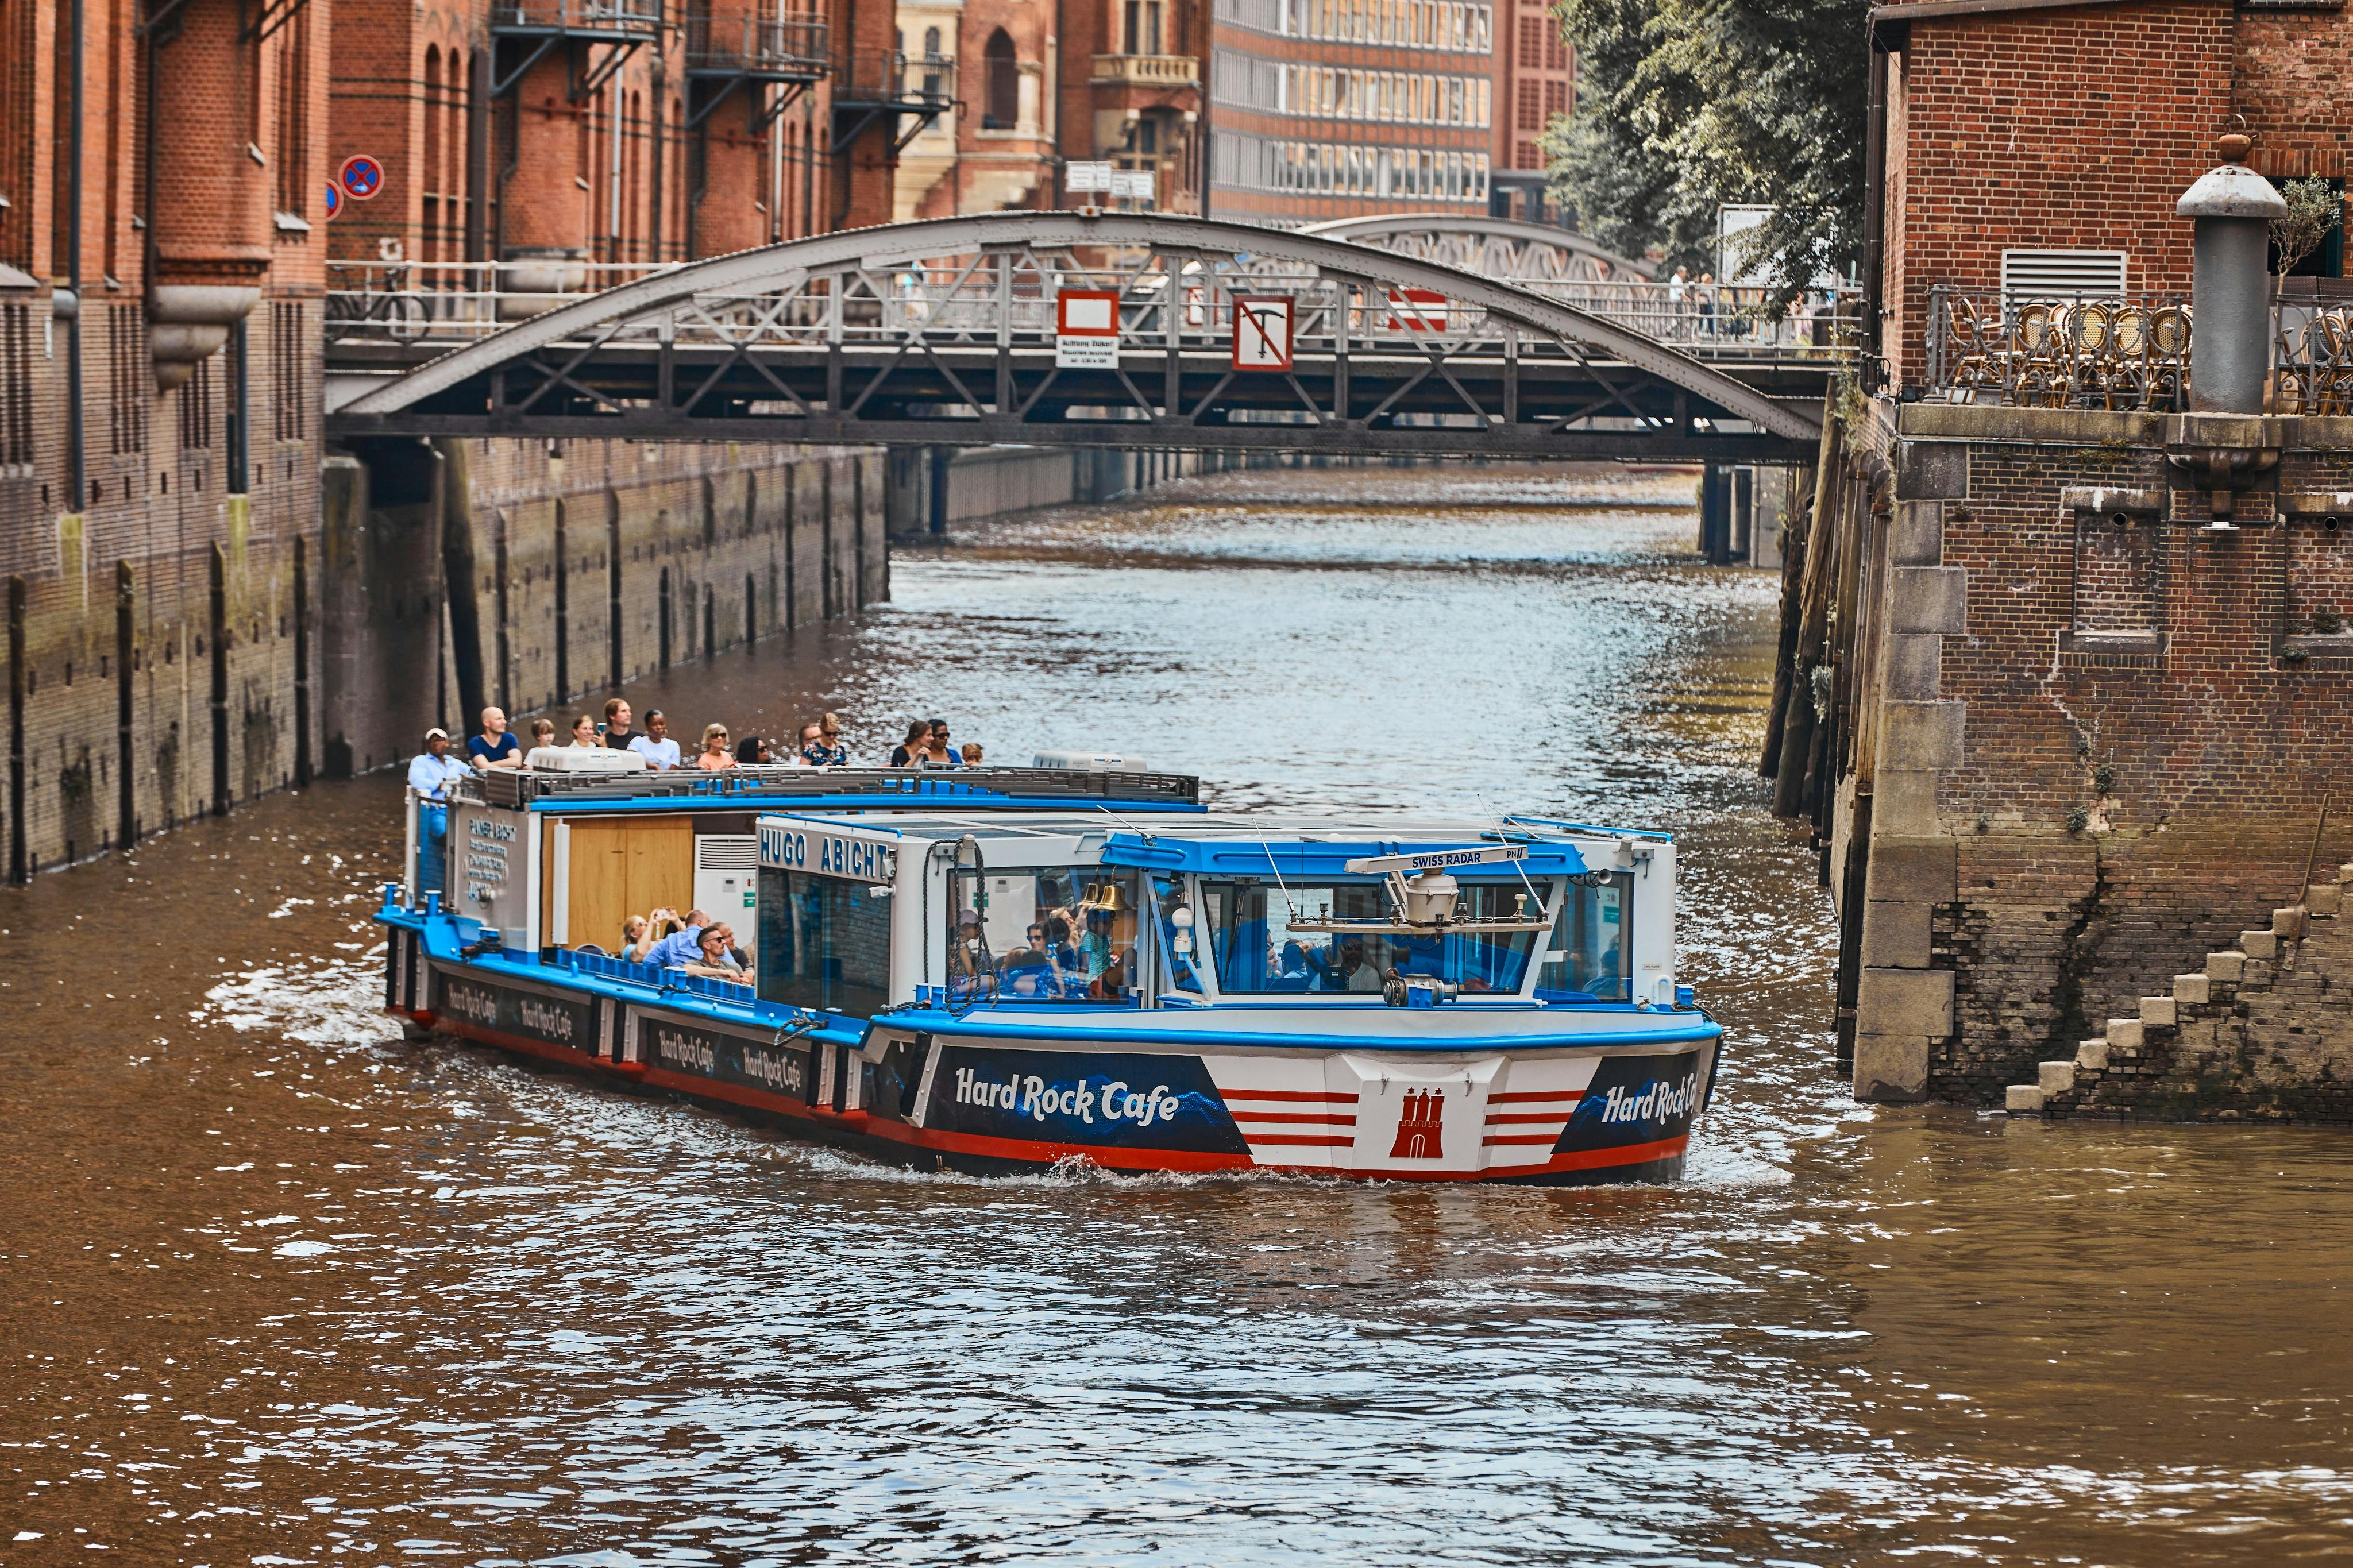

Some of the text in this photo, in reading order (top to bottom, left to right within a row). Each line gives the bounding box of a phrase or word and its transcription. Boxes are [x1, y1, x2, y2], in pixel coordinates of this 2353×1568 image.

[761, 828, 889, 879] HUGO ABICHT
[1413, 852, 1480, 868] SWISS RADAR
[448, 983, 496, 1024] Hard Rock Cafe
[521, 1000, 572, 1041] Hard Rock Cafe
[659, 1030, 714, 1072] Hard Rock Cafe
[743, 1046, 800, 1091] Hard Rock Cafe
[956, 1067, 1179, 1127] Hard Rock Cafe
[1602, 1083, 1657, 1123] Hard
[1655, 1076, 1686, 1125] Rock
